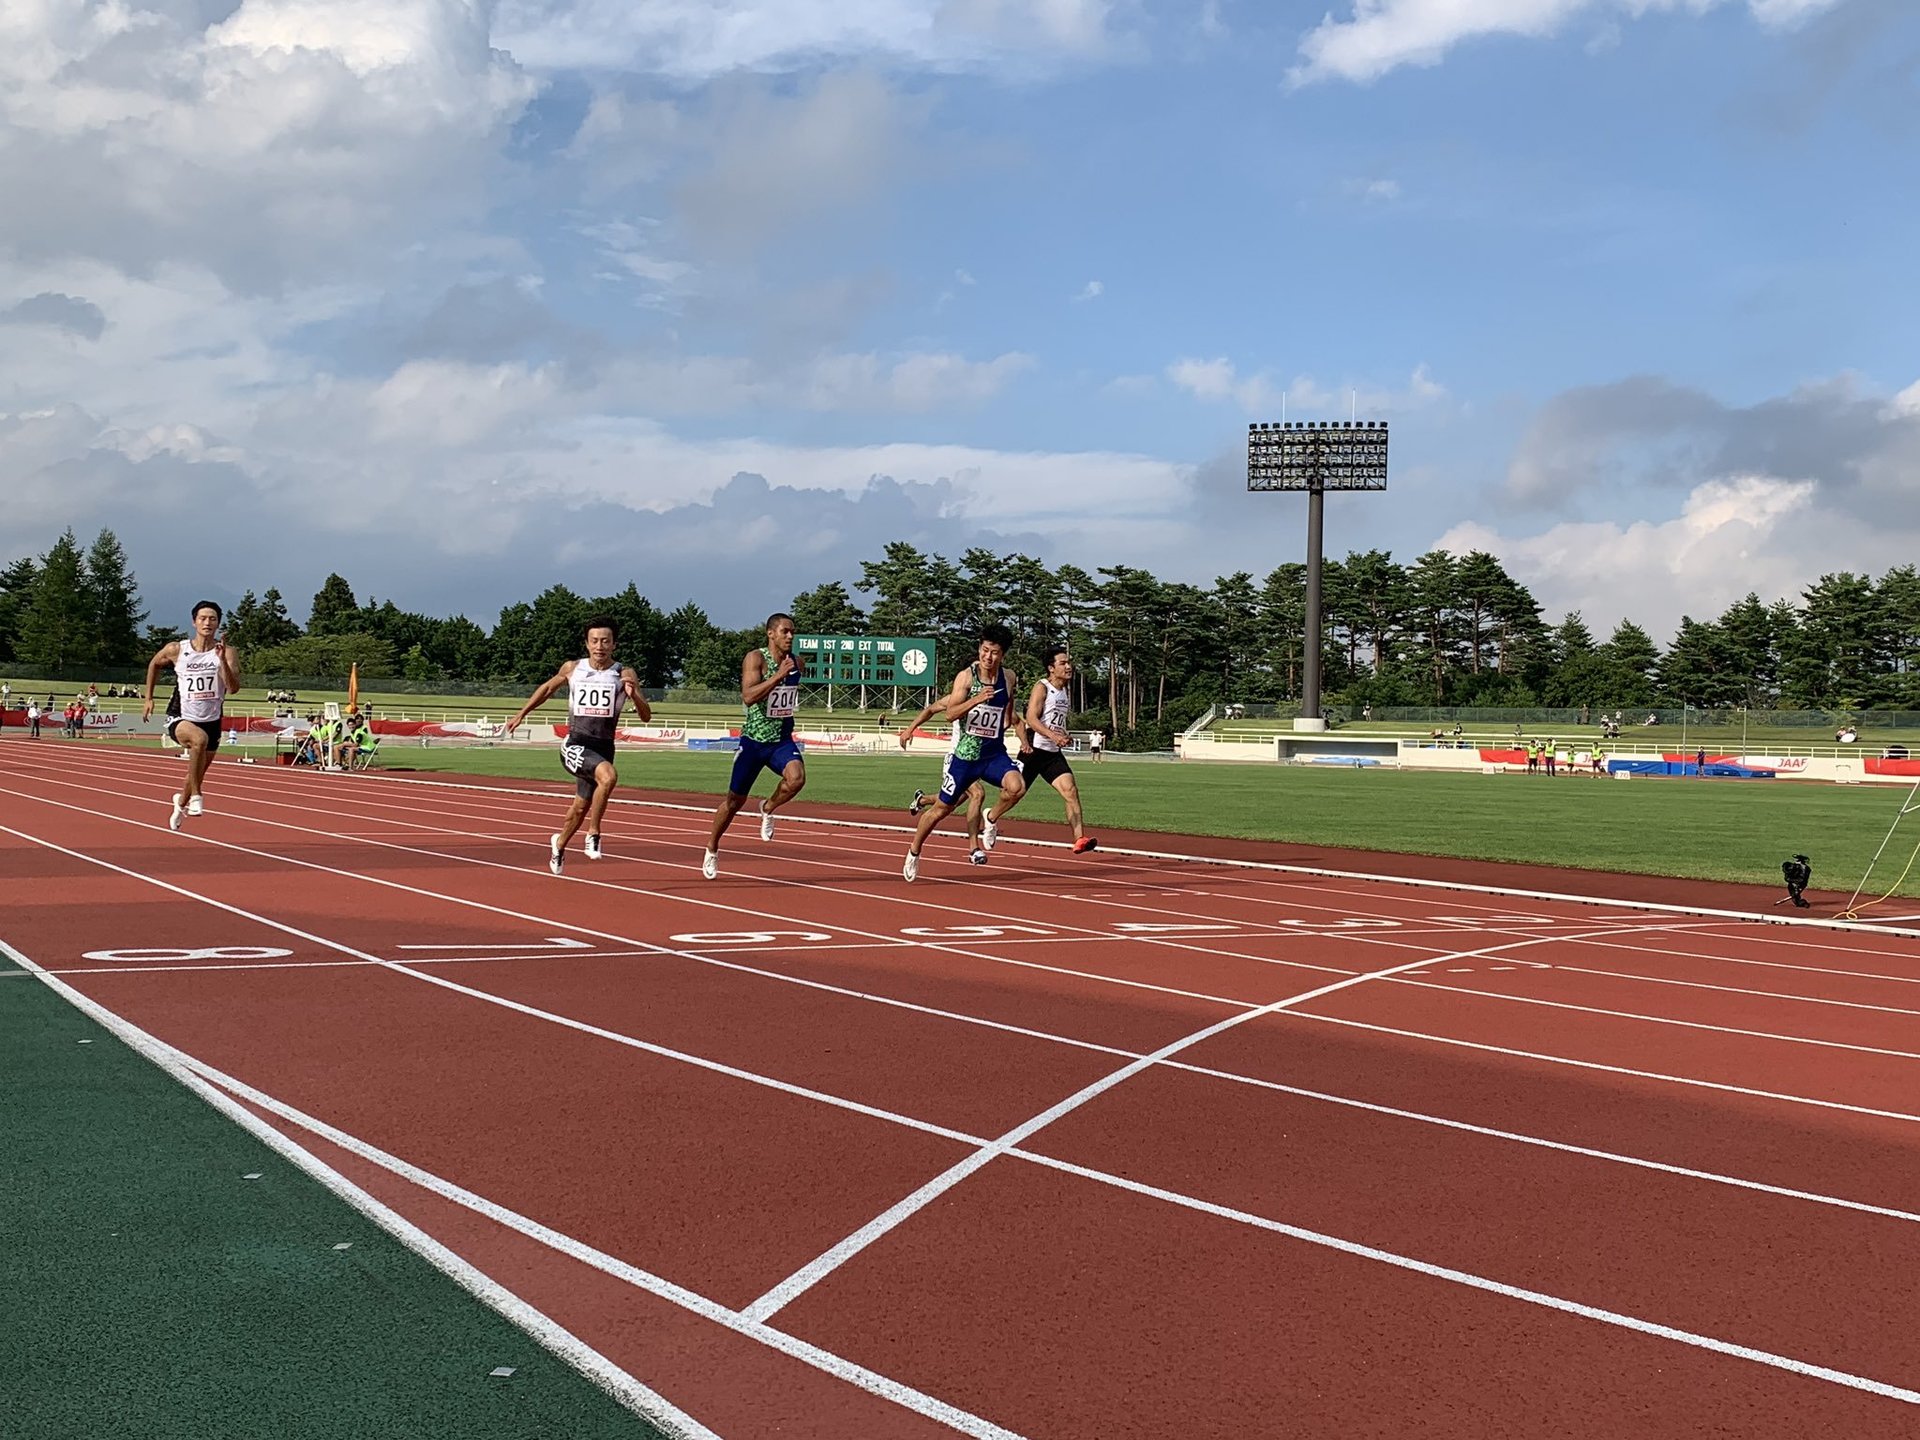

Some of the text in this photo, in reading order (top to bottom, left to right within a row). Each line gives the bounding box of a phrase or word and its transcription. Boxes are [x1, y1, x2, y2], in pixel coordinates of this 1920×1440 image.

[799, 639, 895, 652] TEAM 1ST 2ND EXT TOTAL
[186, 661, 216, 669] KOREA
[186, 676, 215, 692] 207
[578, 689, 611, 707] 205
[90, 714, 118, 725] JAAF
[970, 709, 999, 729] 202
[1051, 711, 1065, 727] 20
[658, 729, 683, 738] JAAF
[832, 733, 856, 742] JAAF
[566, 746, 583, 769] 205
[1777, 757, 1809, 768] JAAF
[1108, 922, 1242, 932] 4
[1278, 918, 1403, 928] 3
[900, 925, 1060, 937] 5
[669, 931, 832, 944] 6
[80, 946, 294, 962] 8
